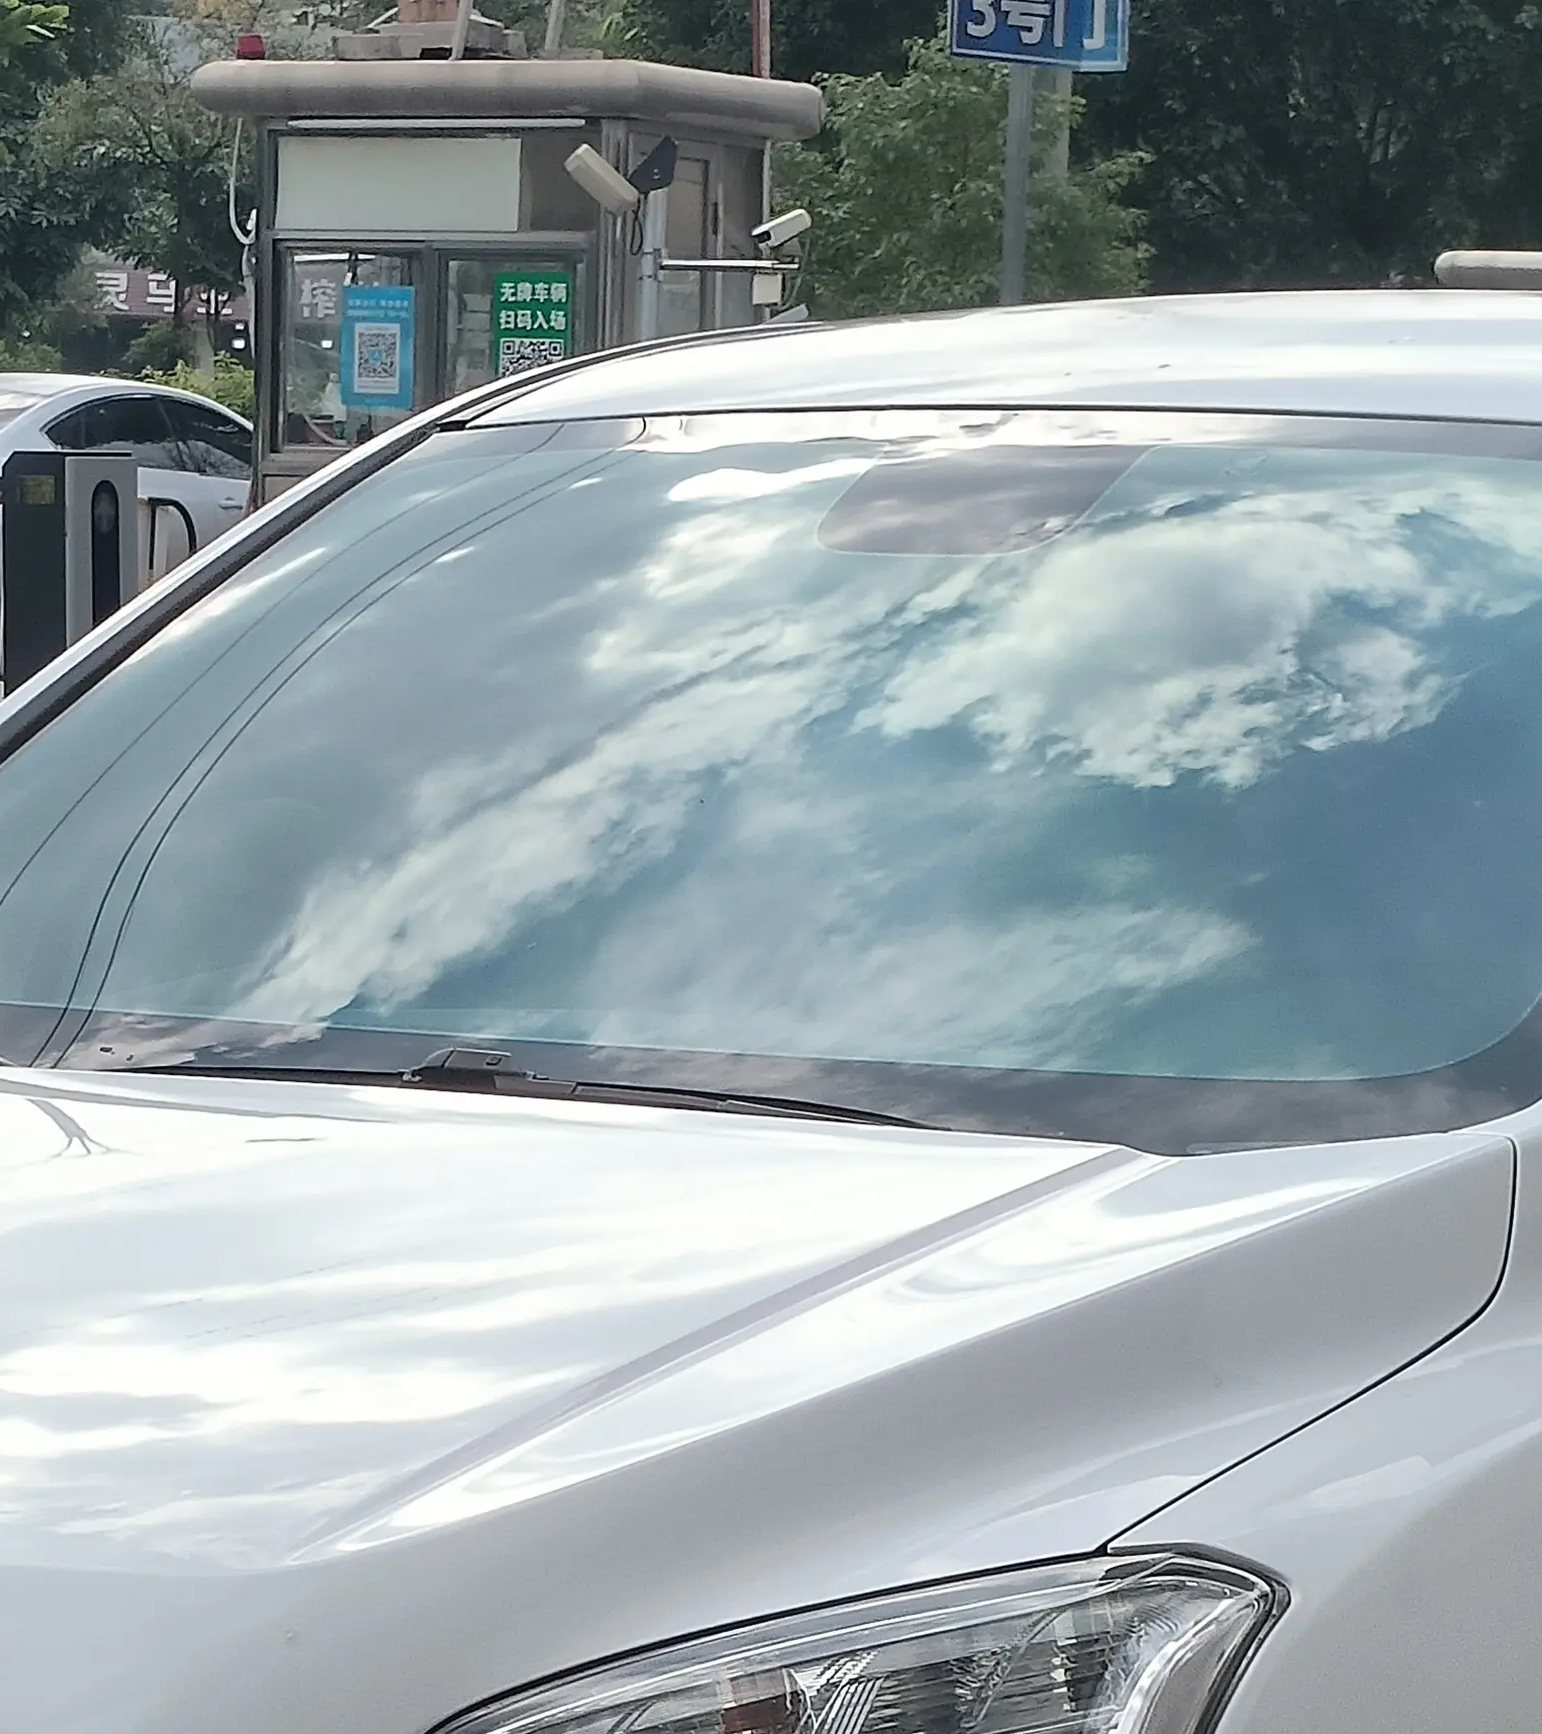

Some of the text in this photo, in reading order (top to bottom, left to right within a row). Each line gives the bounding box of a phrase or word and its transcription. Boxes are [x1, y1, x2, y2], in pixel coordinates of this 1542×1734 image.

[499, 281, 567, 303] 无牌车辆
[499, 309, 567, 330] 扫码入场
